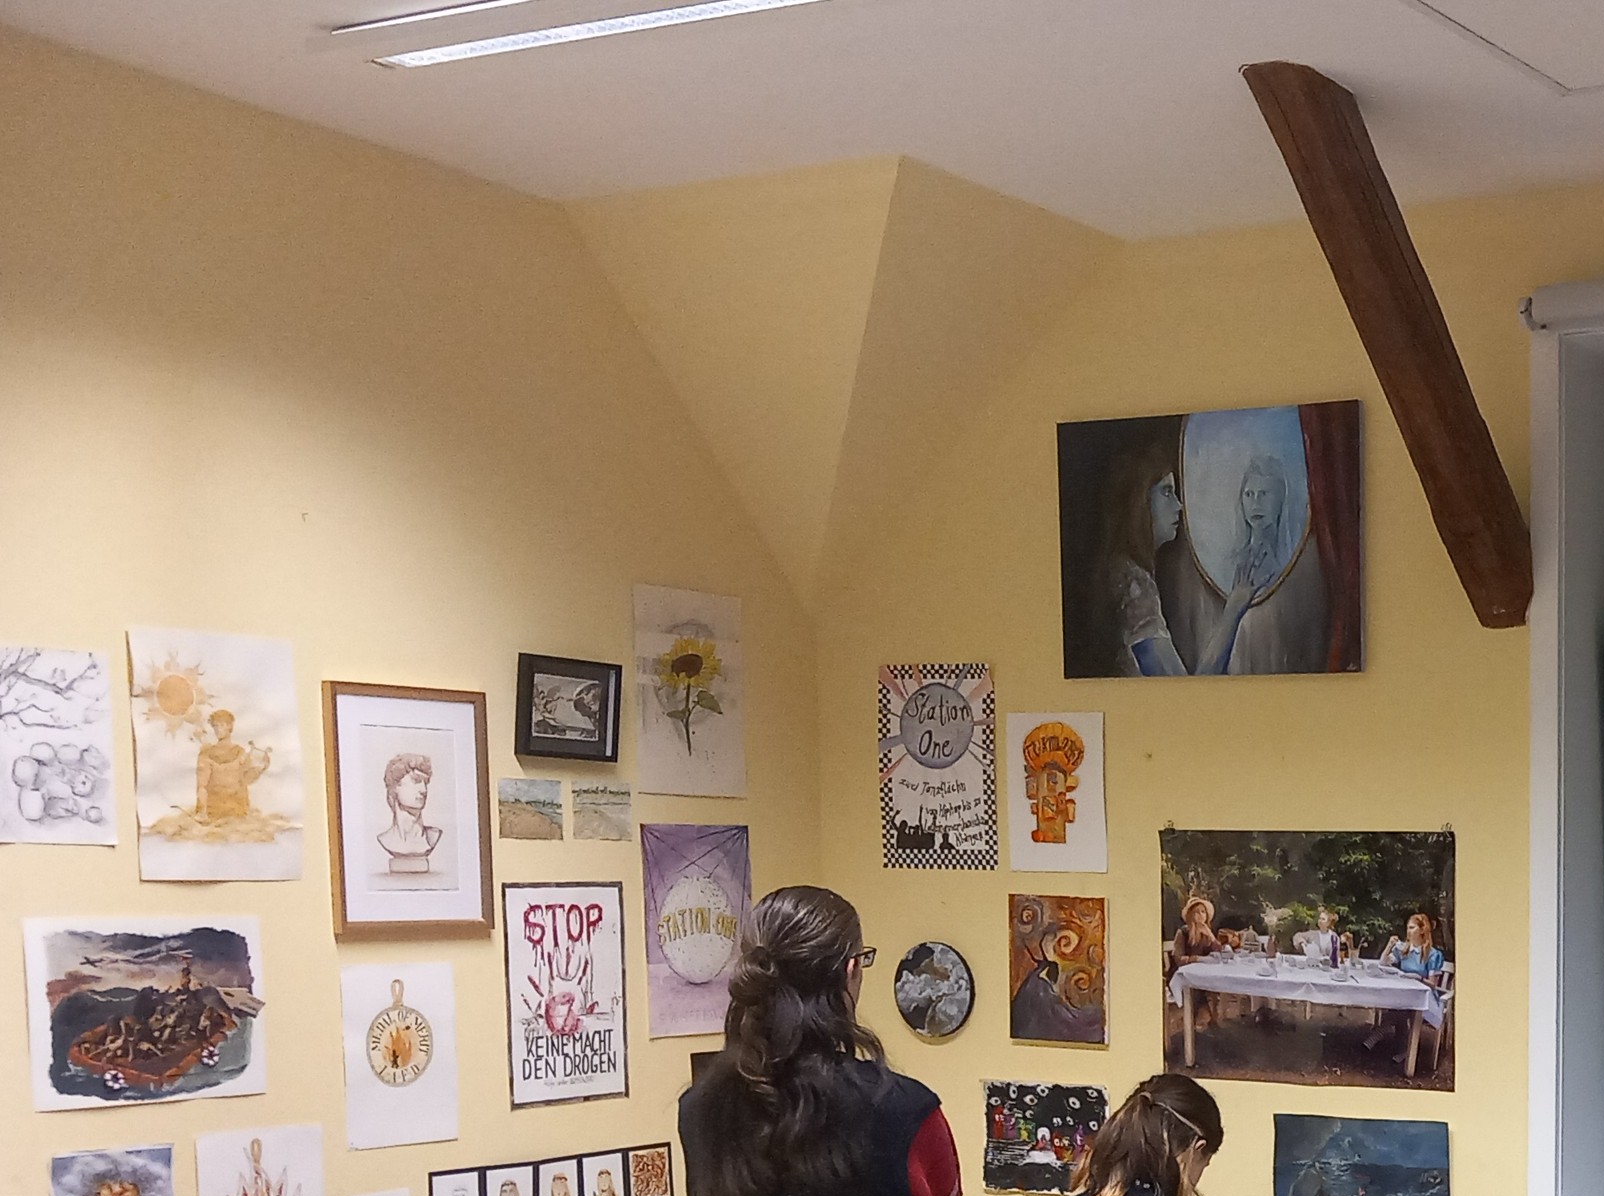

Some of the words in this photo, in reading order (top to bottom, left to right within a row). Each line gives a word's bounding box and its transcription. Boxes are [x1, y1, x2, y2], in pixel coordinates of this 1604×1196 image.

[905, 692, 970, 726] Station
[918, 729, 954, 759] One
[523, 903, 603, 948] STOP
[658, 907, 711, 946] STATION
[397, 1010, 411, 1022] OF
[526, 1033, 570, 1059] KEINE
[572, 1028, 614, 1054] MACHT
[522, 1057, 557, 1080] DEN
[563, 1050, 617, 1078] DROGEN
